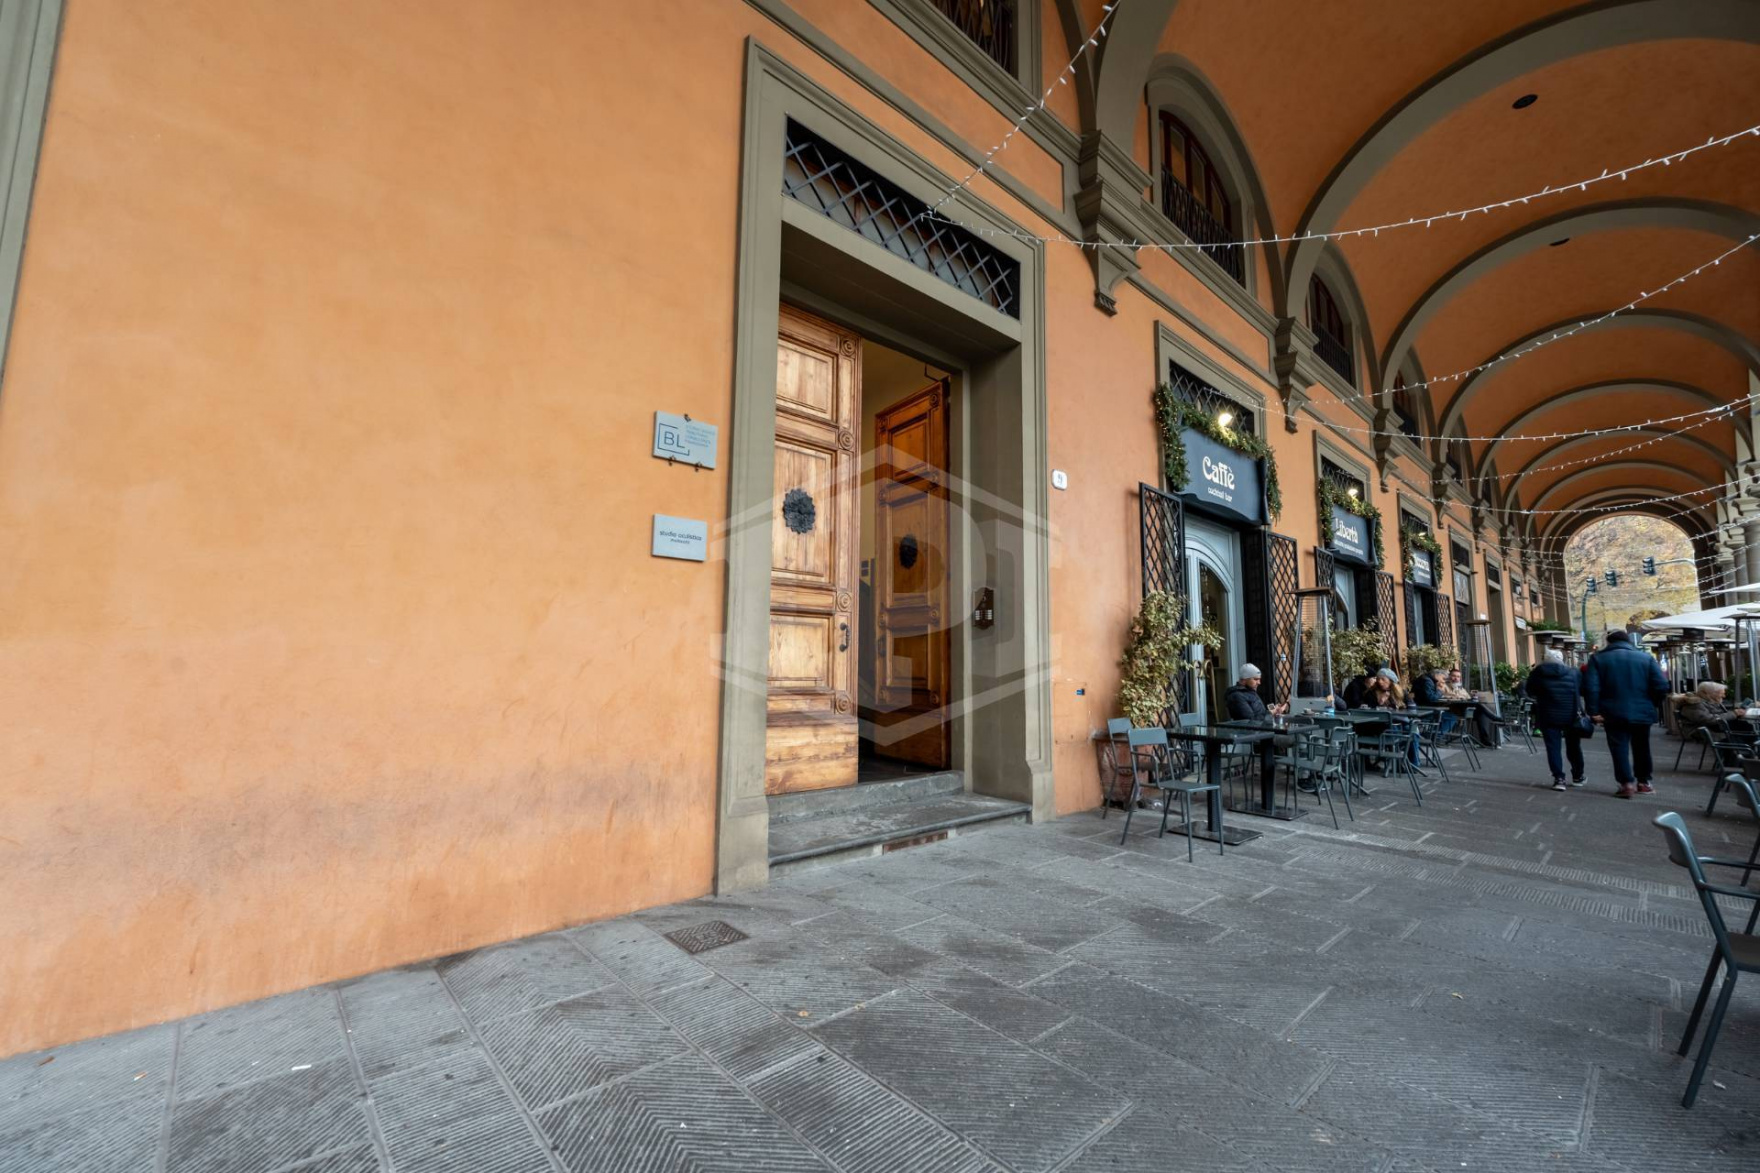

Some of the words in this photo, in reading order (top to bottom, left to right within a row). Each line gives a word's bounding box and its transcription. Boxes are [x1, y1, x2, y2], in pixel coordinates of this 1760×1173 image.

[663, 430, 686, 449] BL
[1203, 456, 1234, 490] Caffè
[1208, 487, 1224, 499] cocktail
